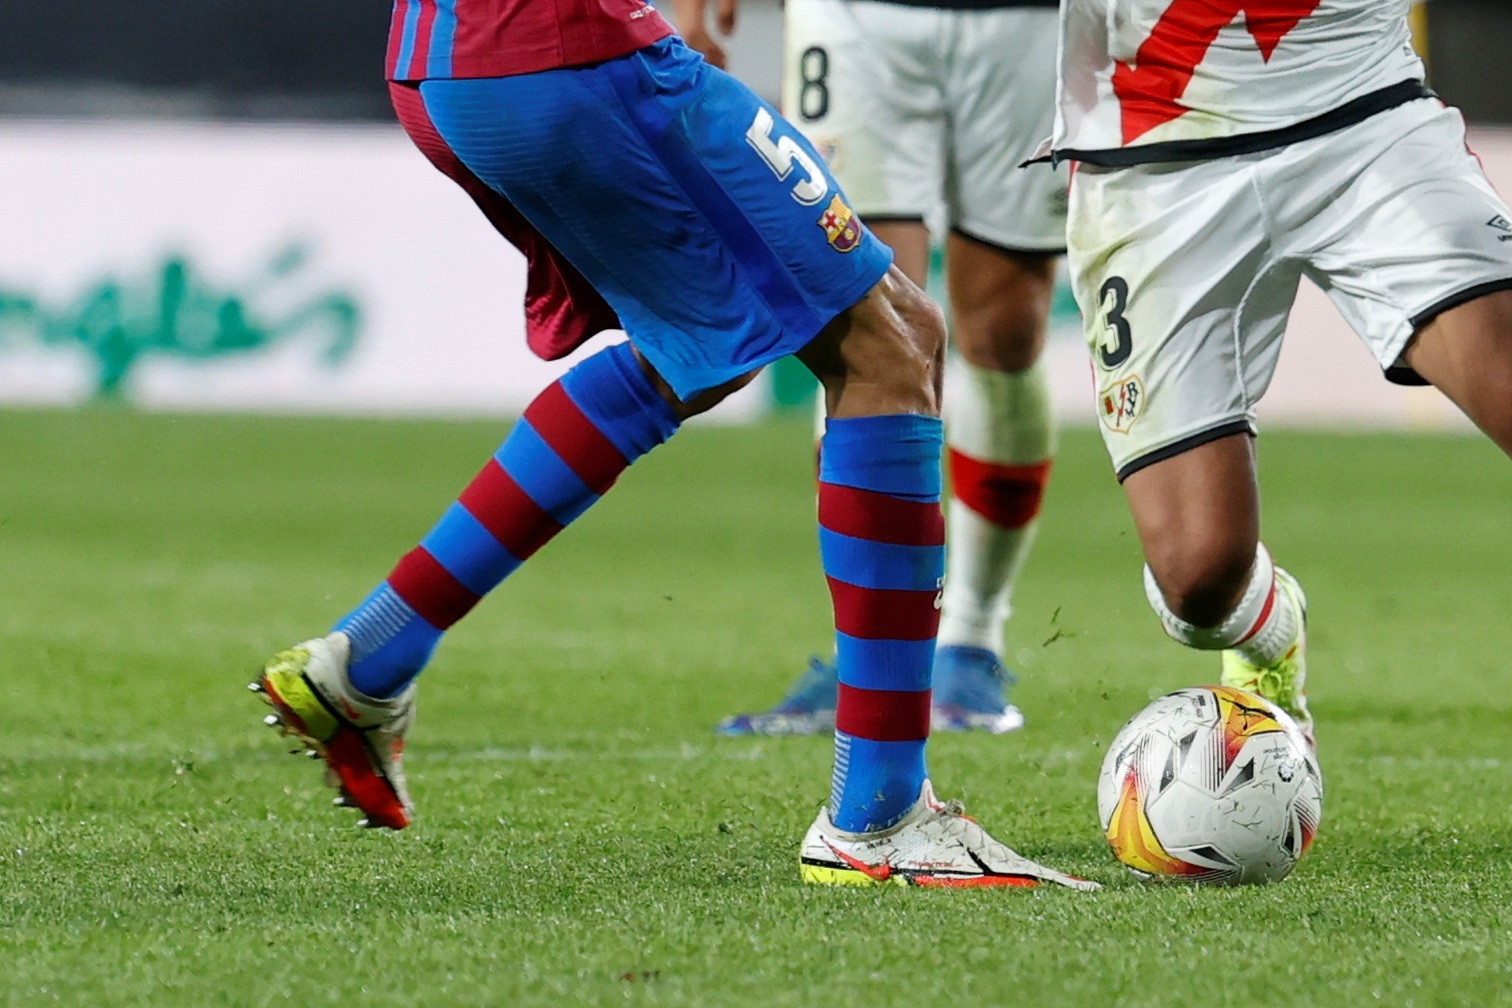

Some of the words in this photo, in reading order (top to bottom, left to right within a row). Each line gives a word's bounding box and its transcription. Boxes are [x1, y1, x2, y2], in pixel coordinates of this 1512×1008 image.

[800, 45, 829, 121] 8
[745, 106, 828, 206] 5
[1097, 276, 1133, 370] 3
